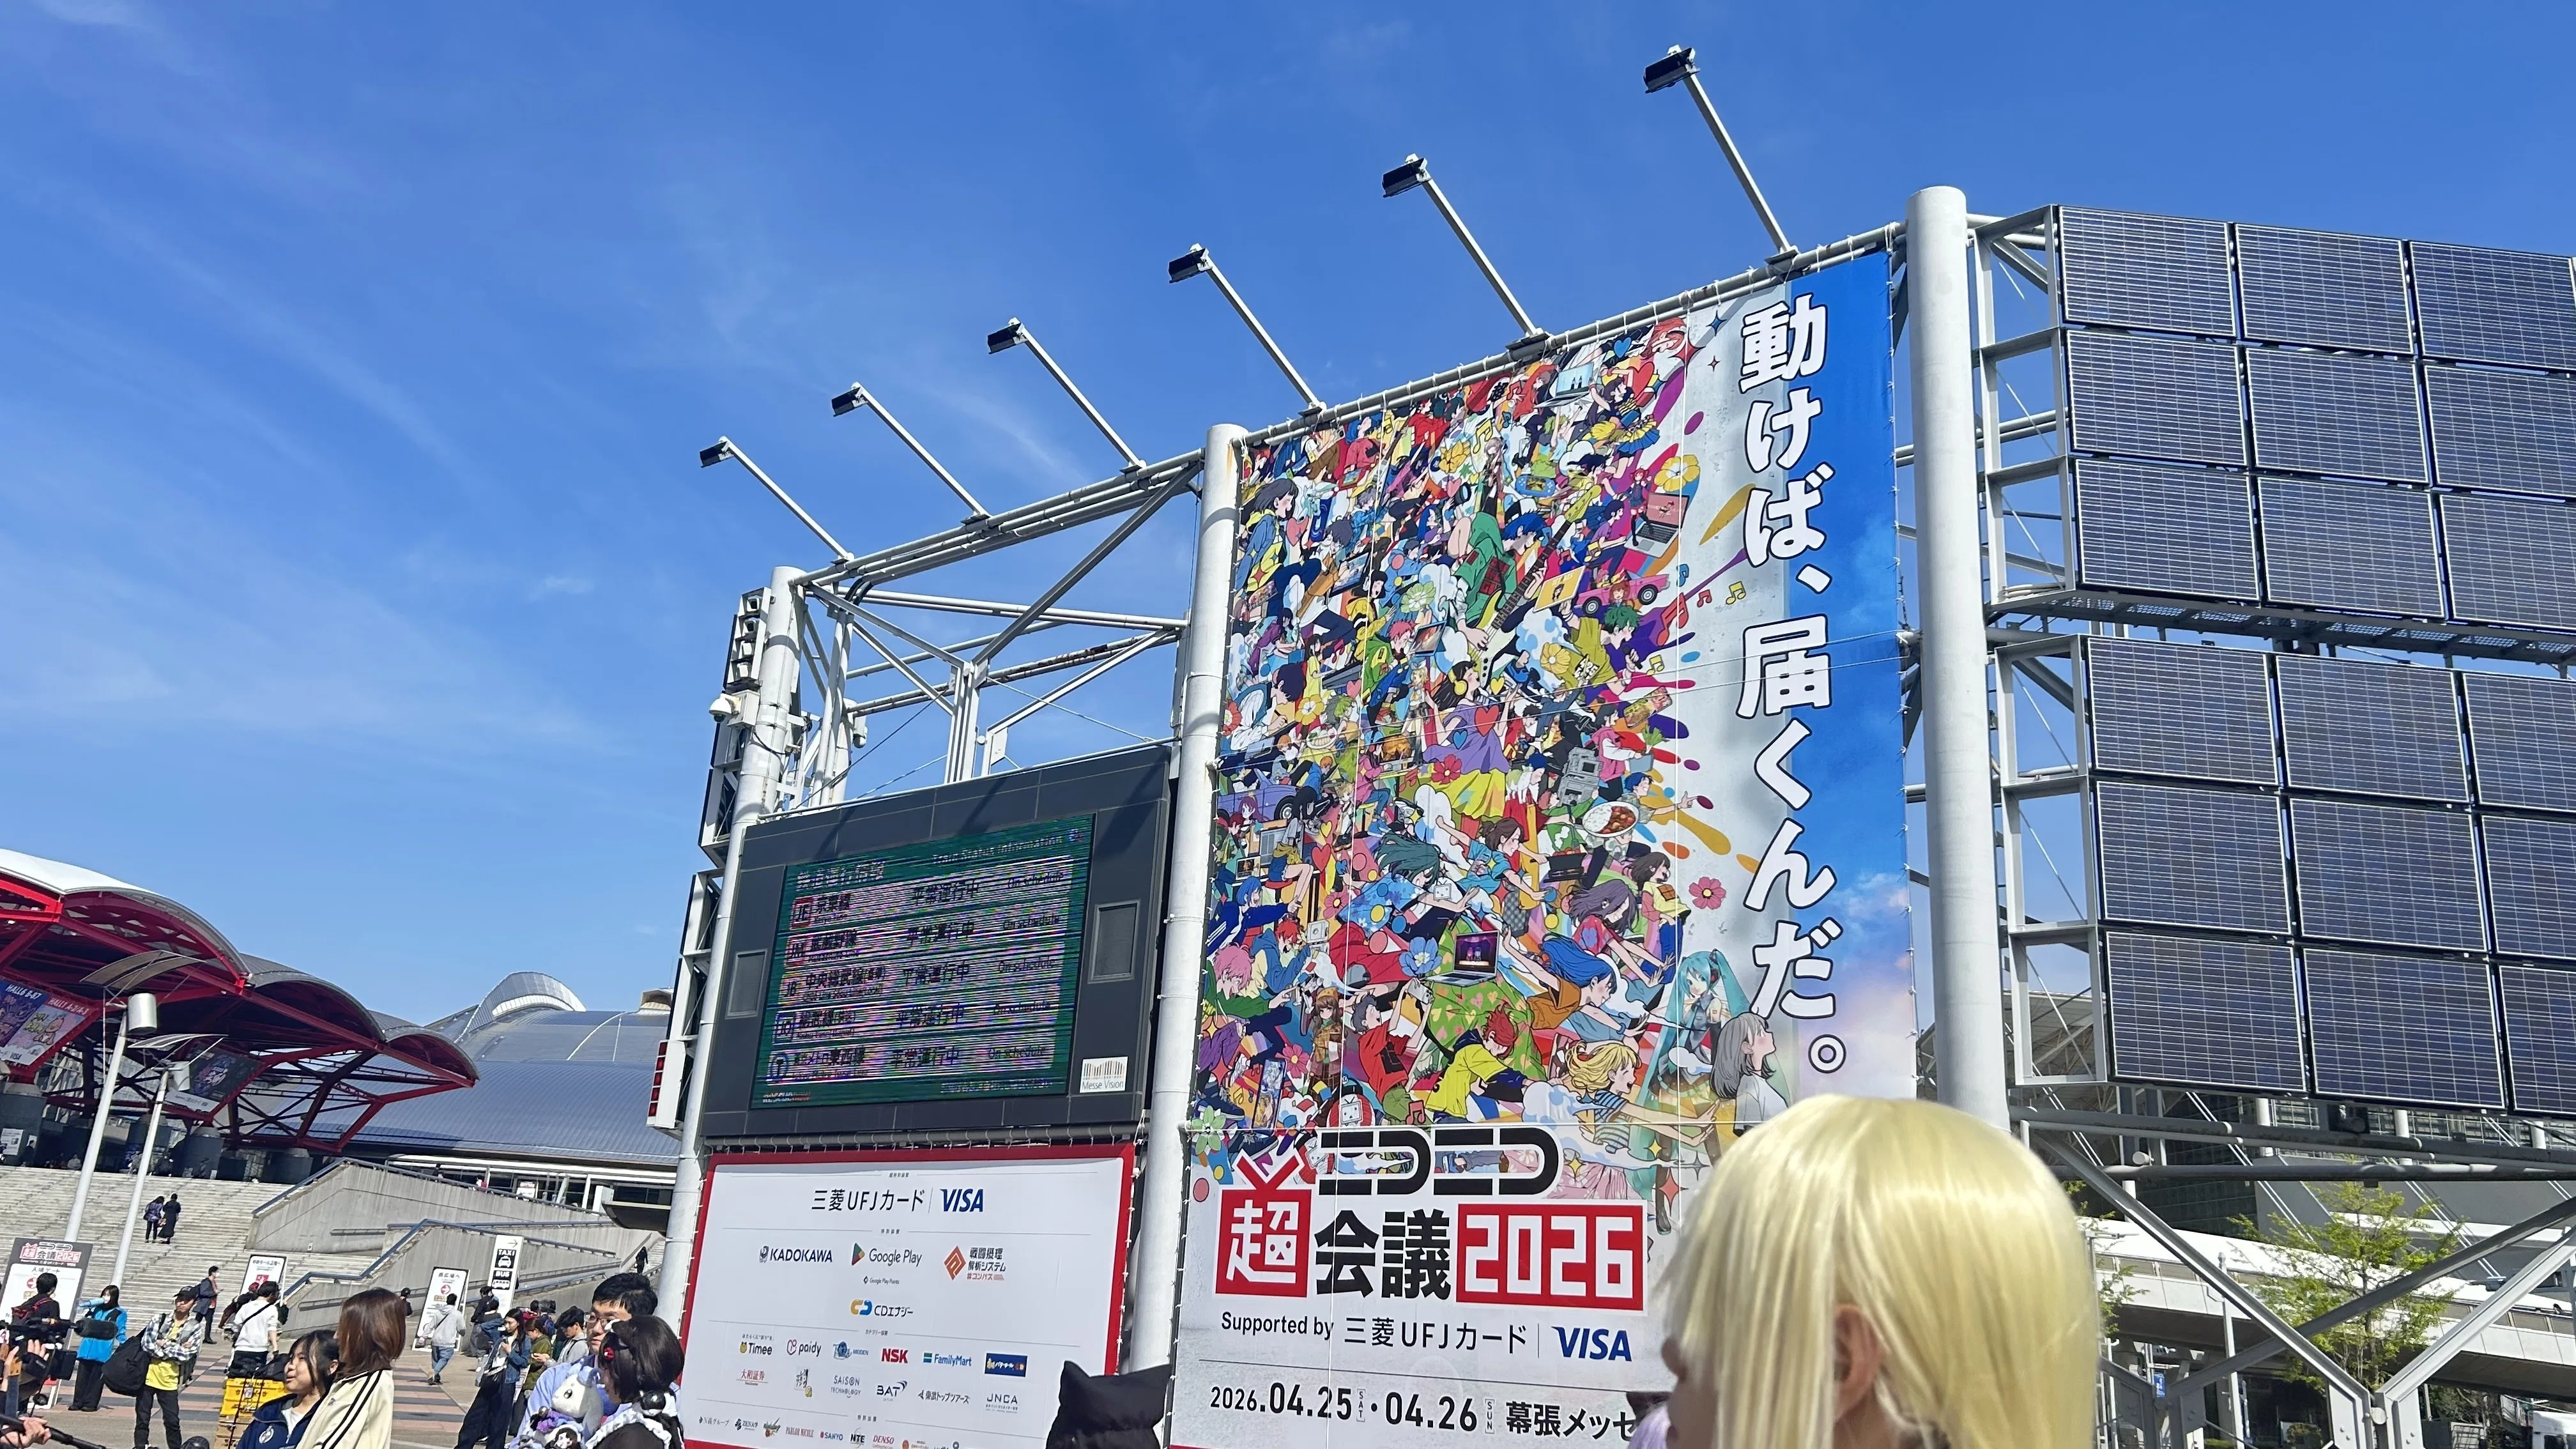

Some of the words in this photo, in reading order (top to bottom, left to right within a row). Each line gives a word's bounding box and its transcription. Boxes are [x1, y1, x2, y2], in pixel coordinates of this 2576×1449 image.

[1736, 293, 1846, 1073] 動けば、届くんだ。
[1082, 1080, 1102, 1090] Messe
[1104, 1078, 1124, 1089] Vision
[1317, 1127, 1560, 1197] ニコニコ
[811, 1188, 925, 1211] 三菱UFJカード
[939, 1188, 984, 1212] VISA
[770, 1248, 832, 1262] KADOKAWA
[869, 1248, 900, 1266] Google
[903, 1249, 923, 1267] Play
[874, 1305, 914, 1317] CDエナジー
[1221, 1311, 1308, 1336] Supported
[1314, 1316, 1334, 1340] by
[1344, 1317, 1527, 1354] 三菱UFJカード
[1551, 1326, 1632, 1362] VISA
[748, 1342, 772, 1355] Timee
[799, 1341, 822, 1357] paidy
[881, 1348, 908, 1363] NSK
[934, 1354, 972, 1366] FamilyMart
[741, 1369, 765, 1381] 大和証券
[833, 1375, 860, 1386] SAISON
[986, 1393, 1018, 1404] JNCA
[1210, 1382, 1353, 1421] 2026.04.25
[1506, 1401, 1636, 1443] 幕張メッセ
[824, 1432, 843, 1441] SANYO
[850, 1434, 865, 1444] NTE
[873, 1435, 894, 1445] DENSO
